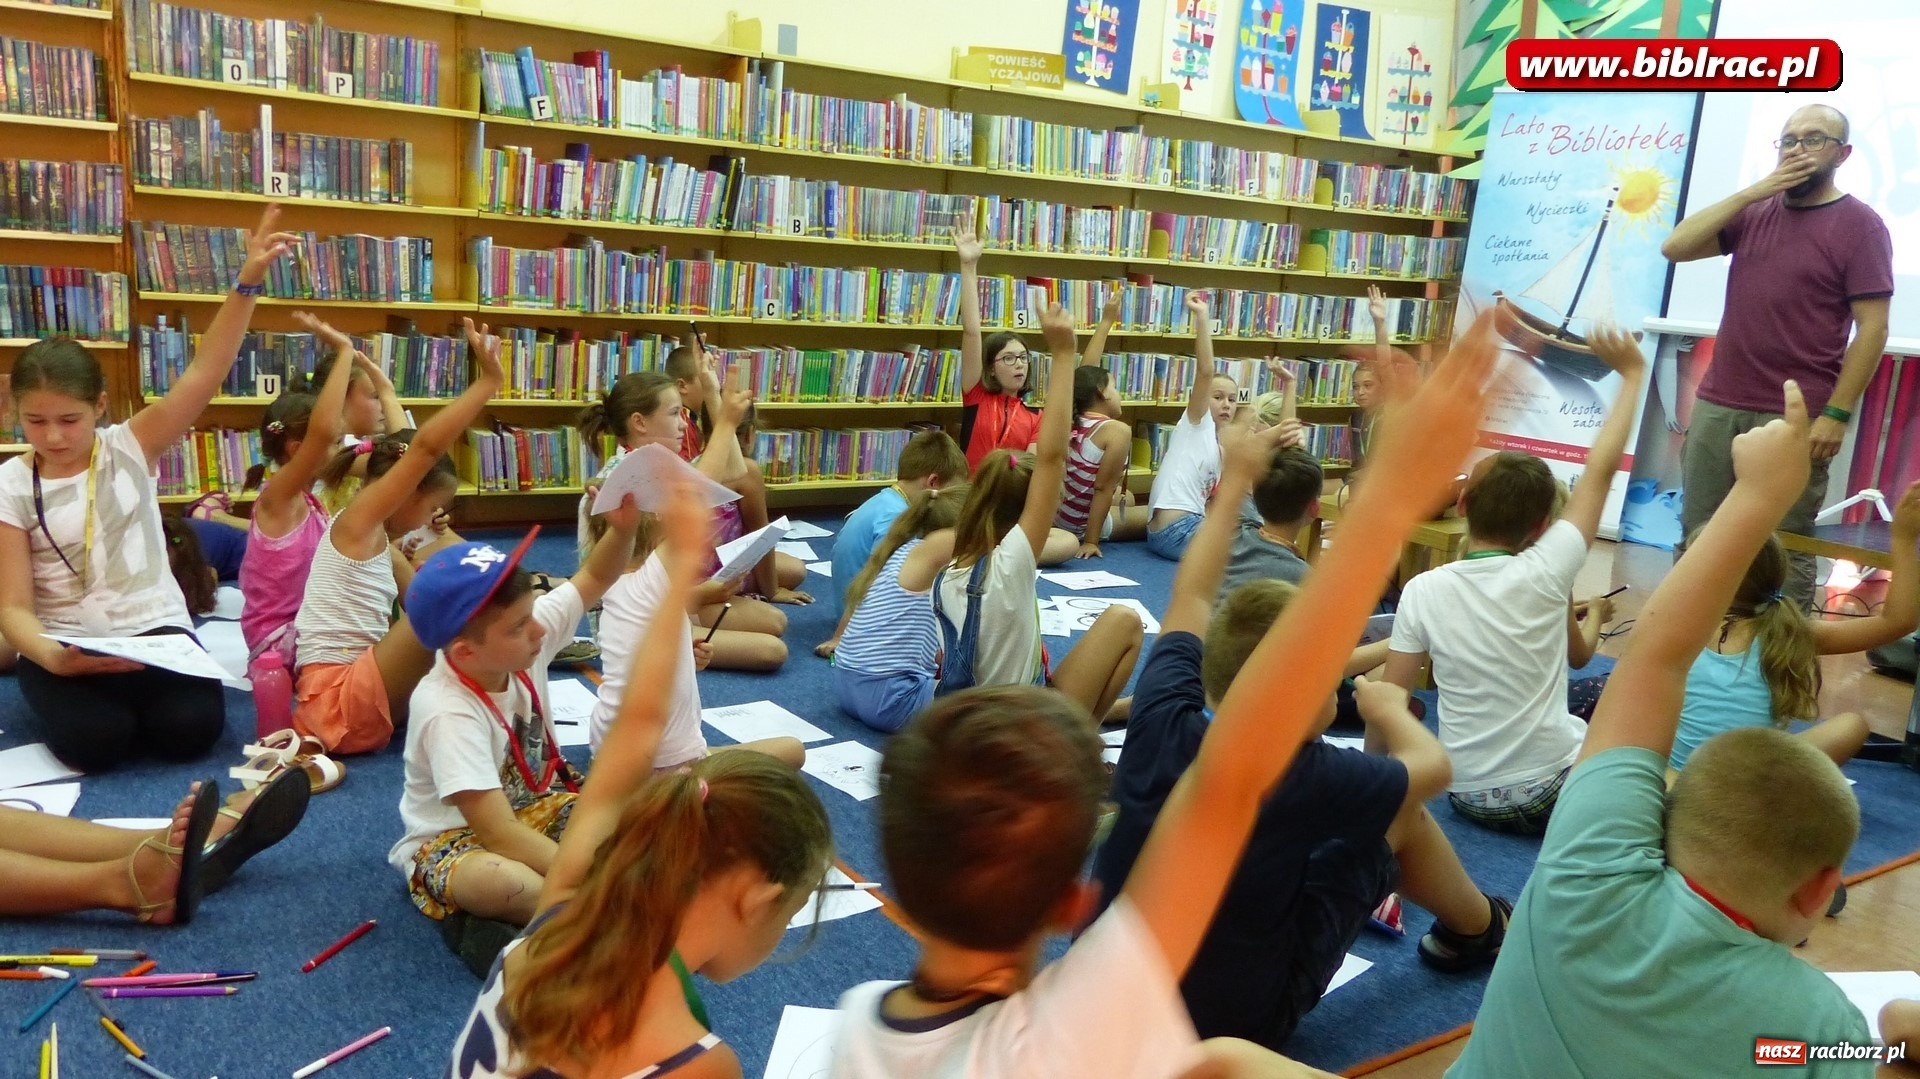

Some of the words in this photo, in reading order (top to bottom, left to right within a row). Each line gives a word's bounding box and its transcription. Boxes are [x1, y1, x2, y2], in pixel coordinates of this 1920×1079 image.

[988, 54, 1047, 69] POWIEŚĆ
[989, 68, 1061, 84] YCZAJOWA
[336, 76, 346, 93] P
[537, 99, 546, 116] F
[1501, 112, 1545, 138] Lato
[1528, 142, 1538, 155] z
[1547, 122, 1688, 156] Biblioteką
[272, 176, 282, 193] R
[1248, 181, 1255, 193] F
[1497, 170, 1562, 191] Warsztaty
[1526, 201, 1589, 225] Wycieczki
[793, 219, 801, 233] B
[1350, 260, 1357, 272] R
[1491, 251, 1550, 266] spotkania
[766, 302, 775, 316] C
[1017, 312, 1025, 326] S
[1212, 321, 1219, 333] J
[1322, 325, 1329, 337] S
[264, 378, 275, 395] U
[1238, 390, 1249, 402] M
[1559, 400, 1603, 415] Wesoła
[1573, 415, 1605, 428] zaba
